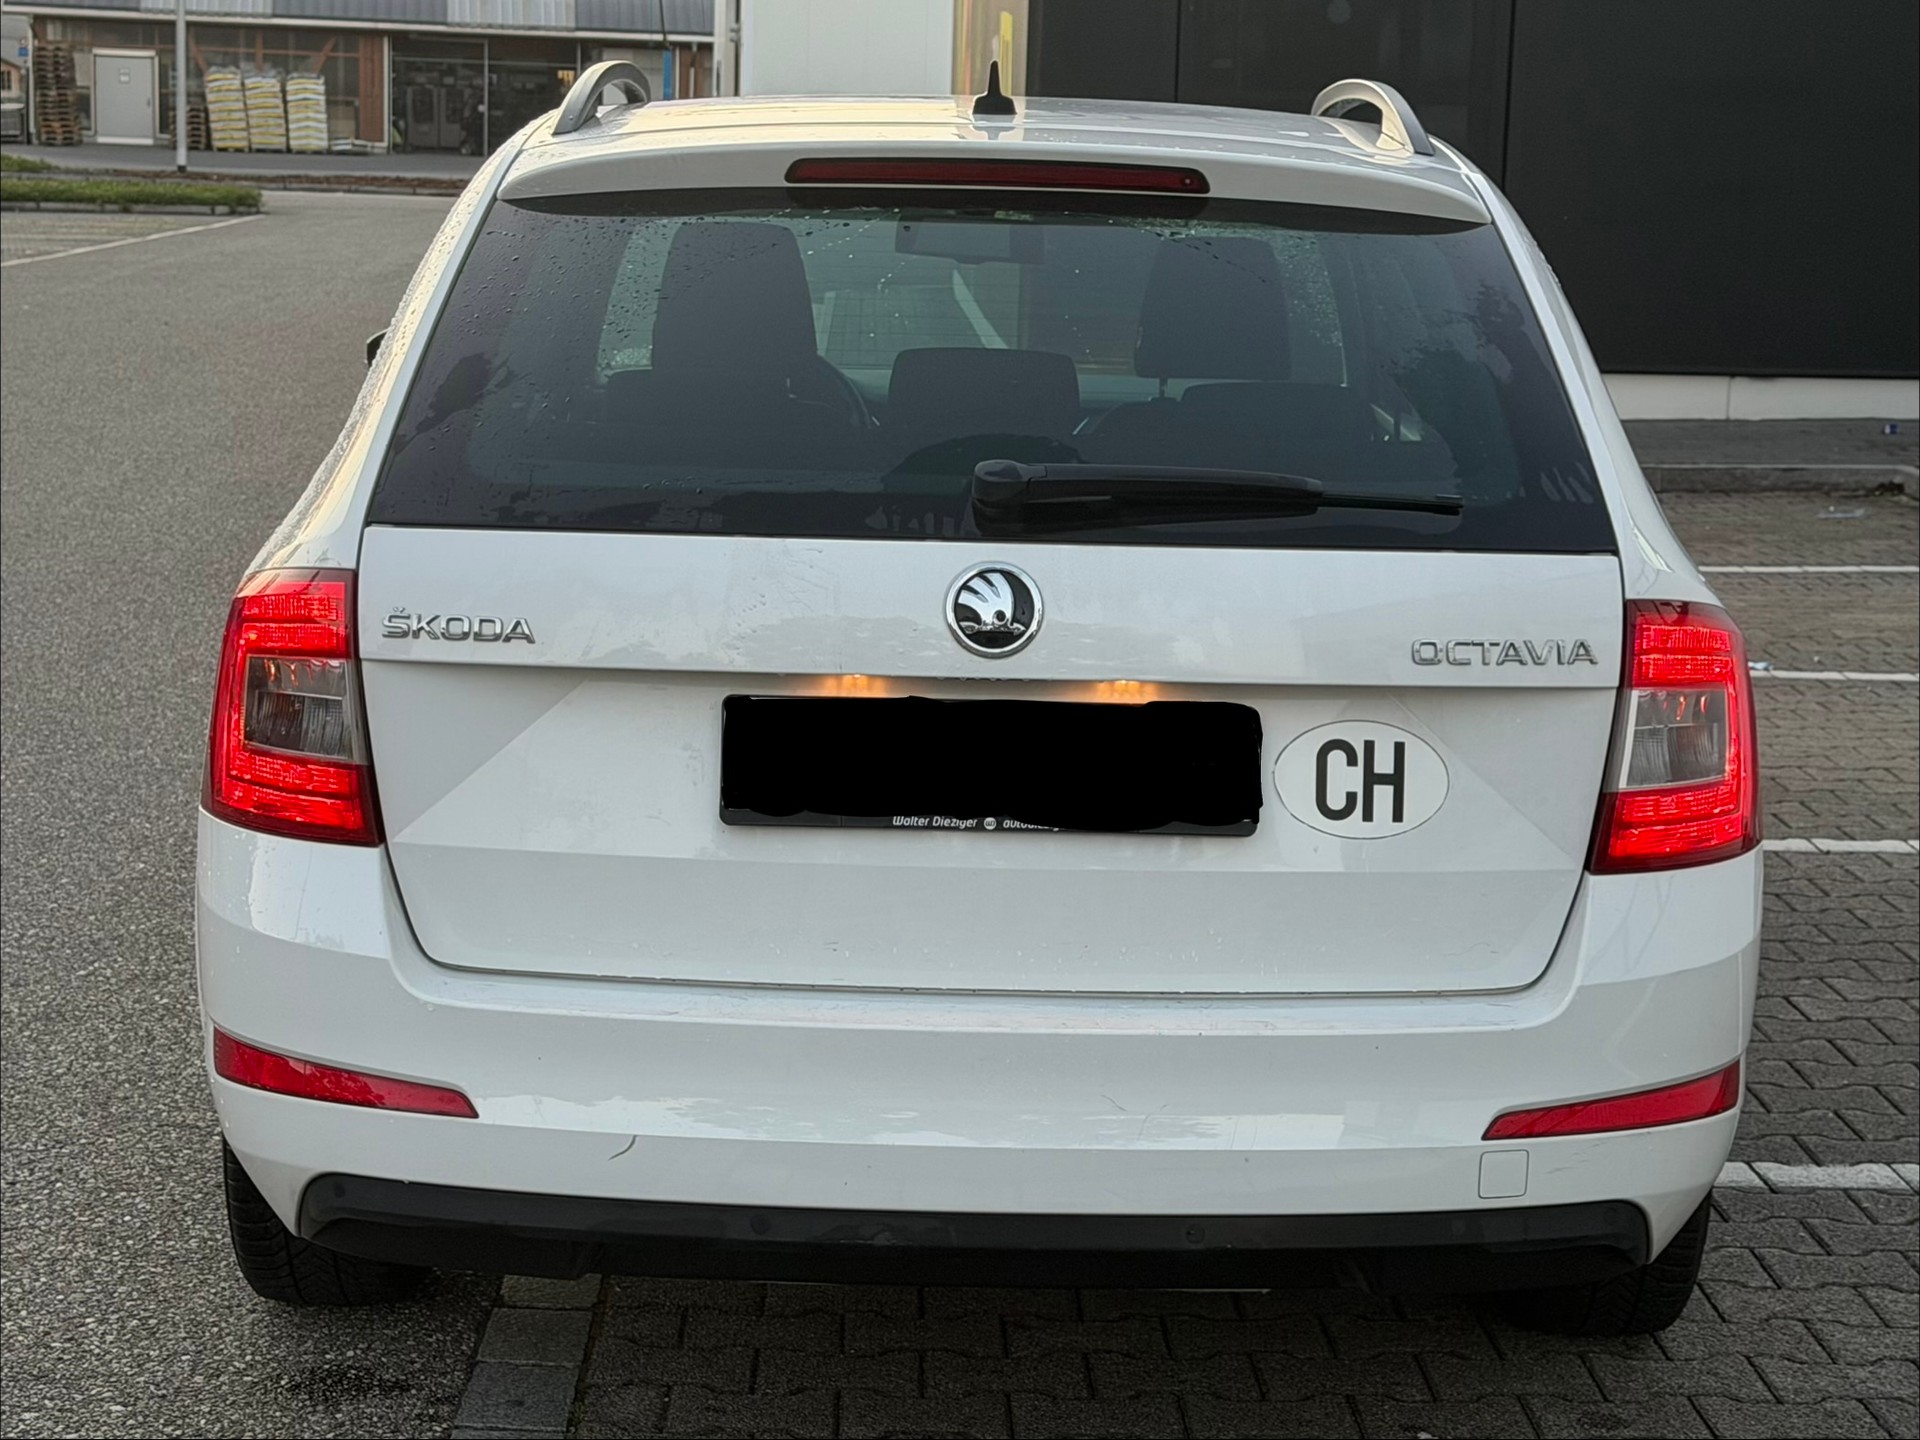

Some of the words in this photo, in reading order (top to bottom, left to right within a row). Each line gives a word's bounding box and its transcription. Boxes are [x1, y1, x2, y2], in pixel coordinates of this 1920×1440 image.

[382, 606, 536, 644] ŠKODA
[1411, 638, 1599, 666] OCTAVIA
[1315, 738, 1406, 823] CH
